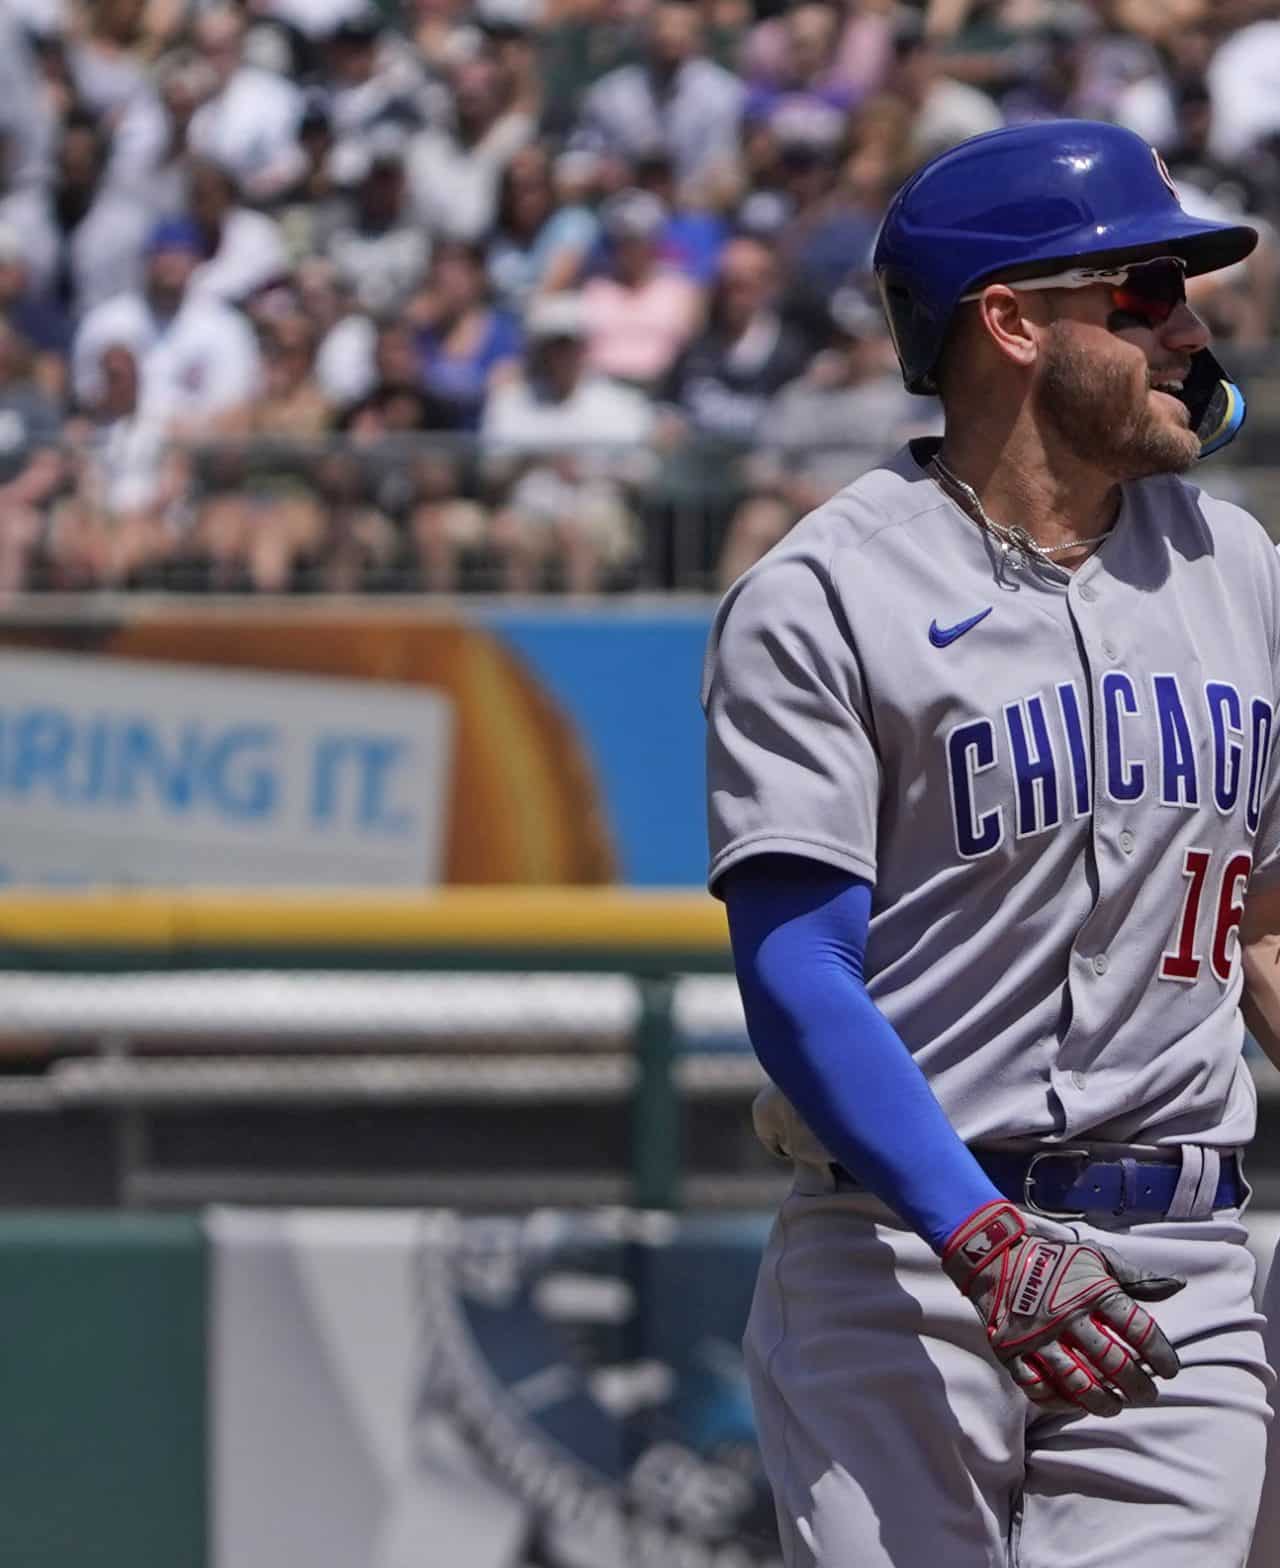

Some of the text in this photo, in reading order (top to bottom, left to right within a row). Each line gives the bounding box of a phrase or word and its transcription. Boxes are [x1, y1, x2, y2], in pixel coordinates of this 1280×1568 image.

[945, 669, 1275, 861] CHICAGO
[1158, 846, 1253, 984] 16
[1018, 1246, 1058, 1312] Franklin
